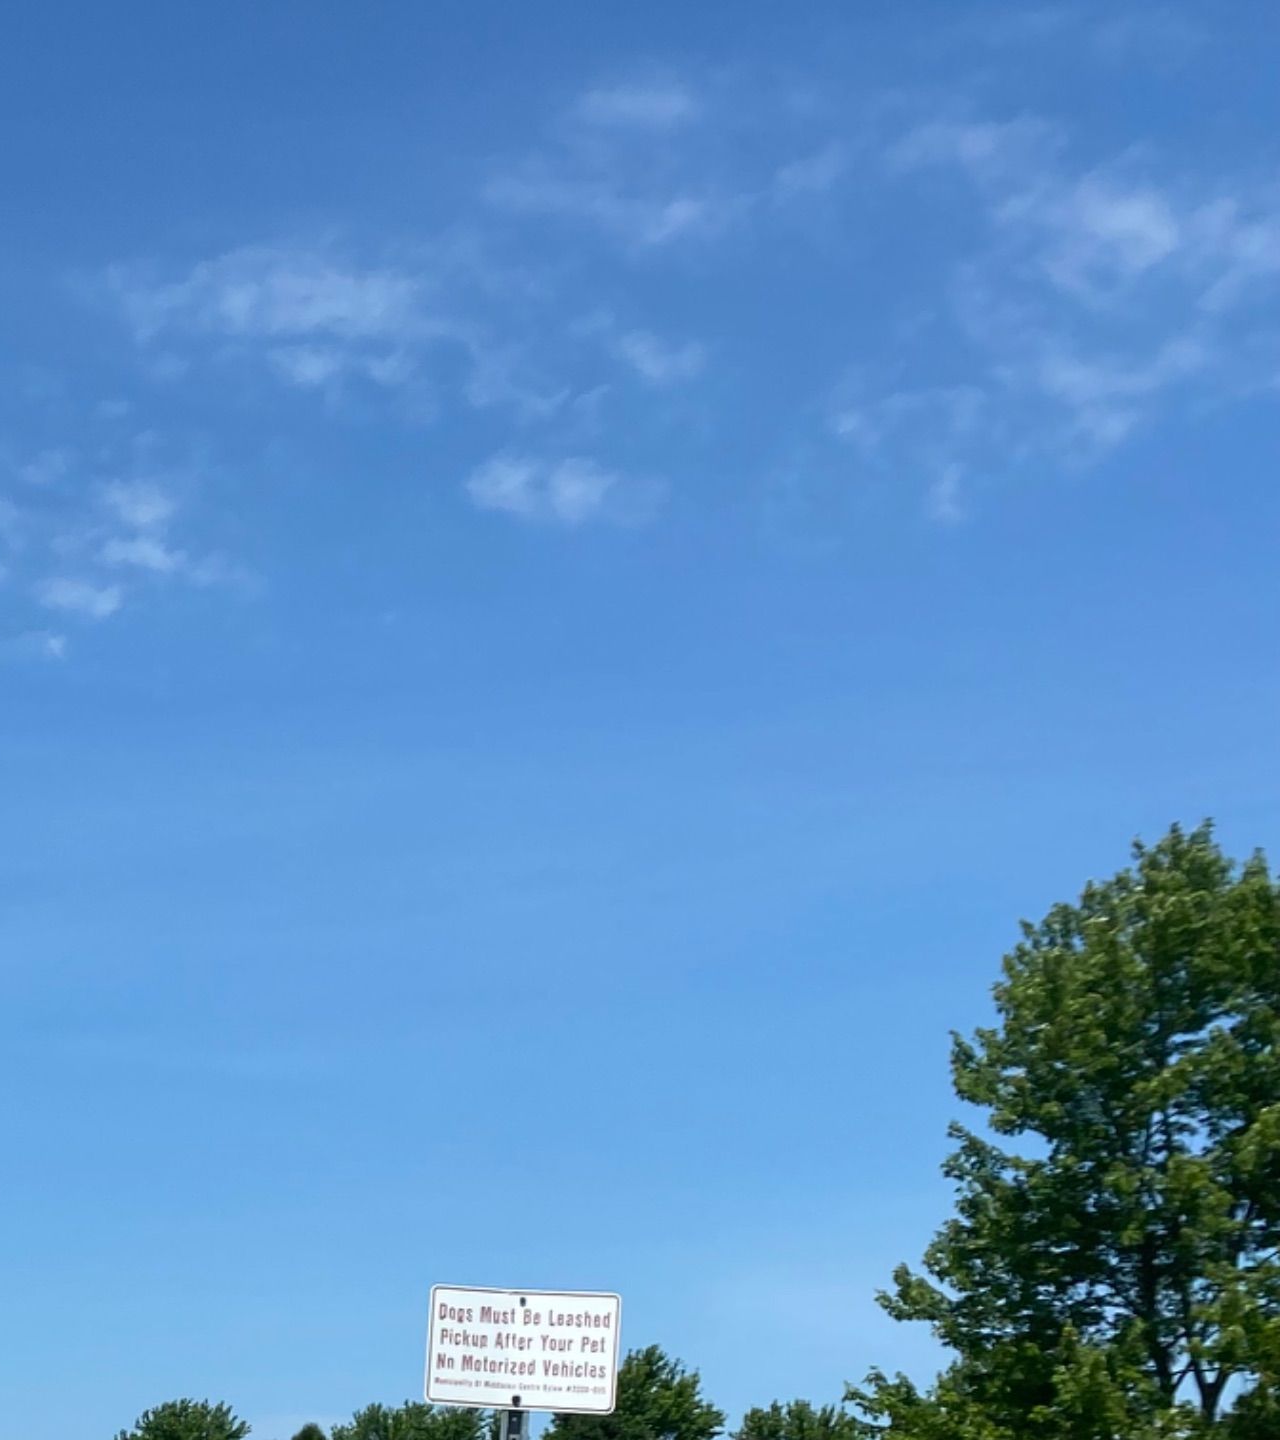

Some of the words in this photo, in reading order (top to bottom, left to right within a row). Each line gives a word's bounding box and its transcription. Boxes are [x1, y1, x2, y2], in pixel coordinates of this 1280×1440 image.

[438, 1303, 473, 1324] Dogs
[480, 1305, 515, 1324] Must
[523, 1308, 541, 1326] Be
[549, 1309, 611, 1329] Leashed
[440, 1328, 488, 1349] Pickup
[494, 1331, 533, 1350] After
[540, 1334, 573, 1352] Your
[581, 1336, 606, 1353] Pet
[461, 1354, 536, 1376] Motorized
[543, 1359, 607, 1379] Vehicles
